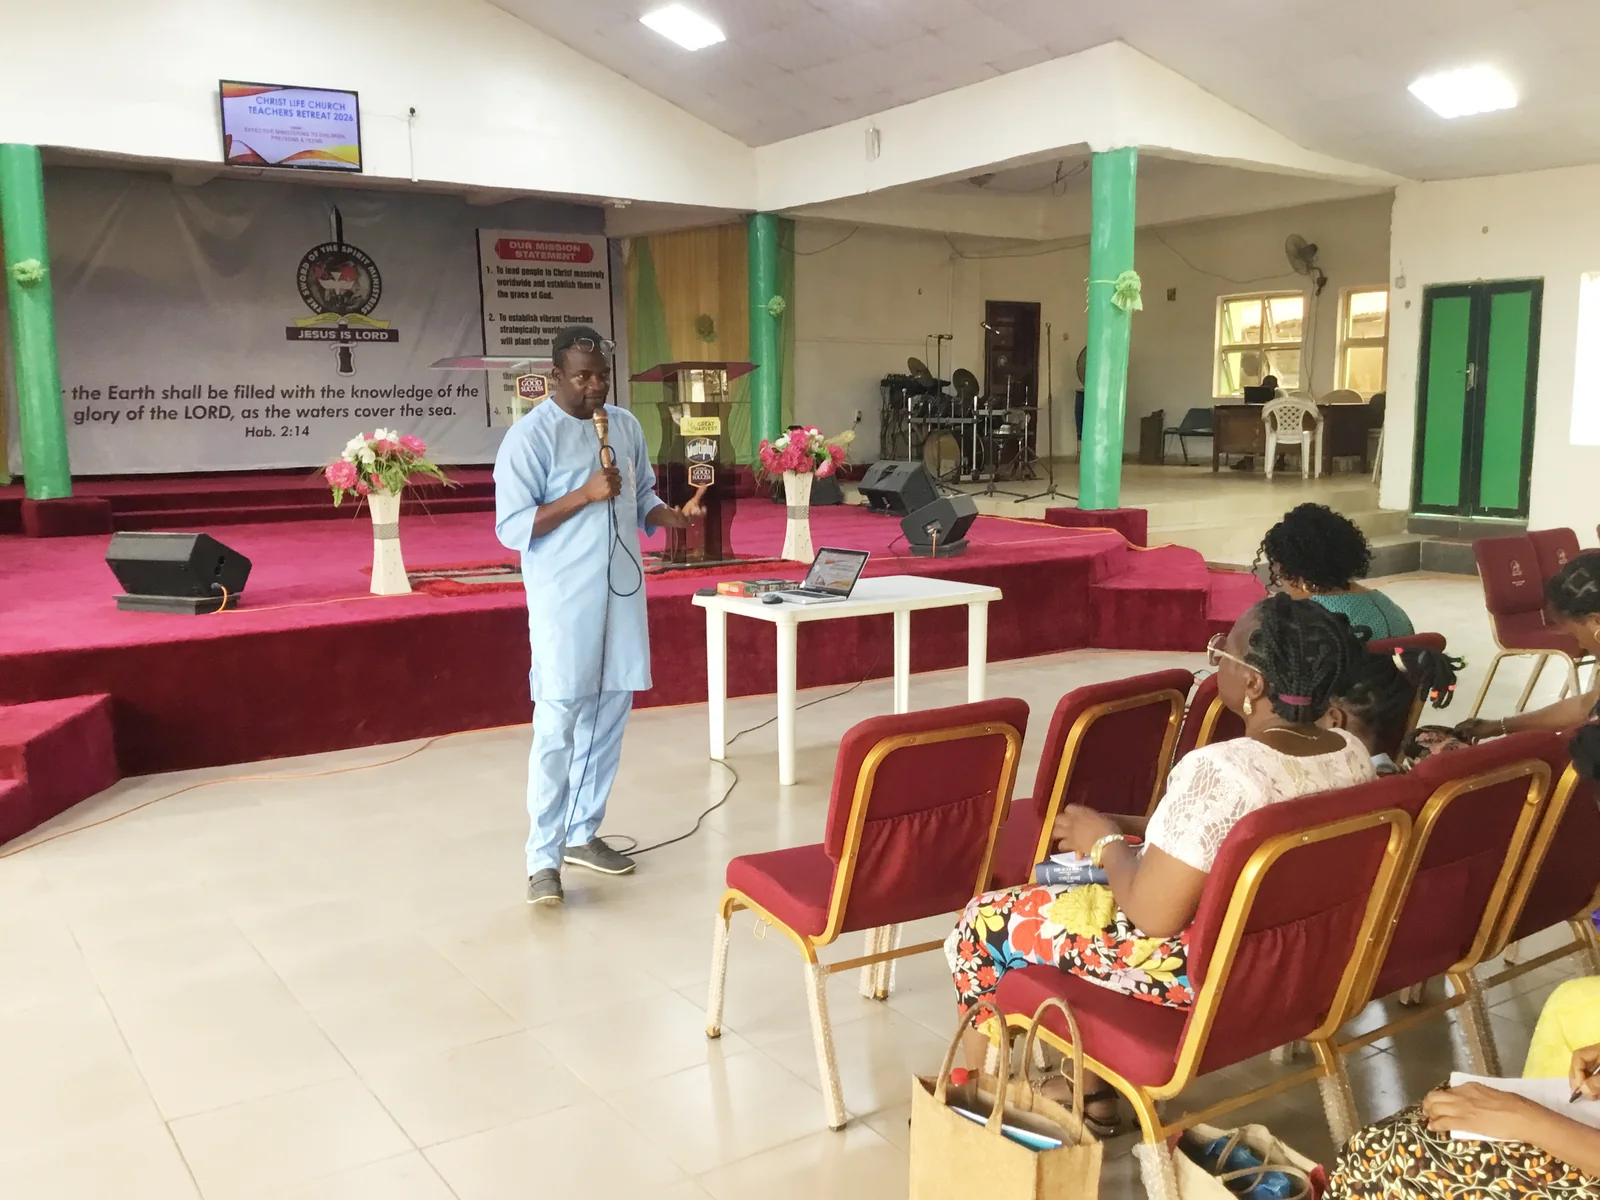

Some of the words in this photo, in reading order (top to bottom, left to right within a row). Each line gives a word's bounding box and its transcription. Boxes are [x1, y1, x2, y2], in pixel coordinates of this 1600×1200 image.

[256, 96, 286, 106] CHRIST
[289, 99, 305, 108] LIFE
[308, 101, 345, 110] CHURCH
[248, 106, 293, 117] TEACHERS
[297, 111, 331, 120] RETREAT
[334, 113, 353, 121] 2026
[320, 245, 338, 254] THE
[509, 241, 532, 249] OUR
[536, 243, 580, 252] MISSION
[308, 250, 319, 261] OF
[341, 246, 370, 265] SPIRIT
[515, 250, 576, 260] STATEMENT
[486, 266, 493, 274] 1.
[496, 266, 503, 274] To
[505, 266, 520, 274] lead
[522, 268, 543, 276] people
[545, 268, 551, 276] to
[553, 268, 572, 276] Christ
[574, 269, 604, 279] massively
[300, 262, 310, 296] SWORD
[496, 279, 531, 287] worldwide
[533, 280, 545, 288] and
[547, 280, 575, 288] establish
[361, 266, 380, 314] MINISTRIES
[497, 290, 508, 298] the
[510, 291, 529, 299] grace
[531, 291, 537, 299] of
[539, 291, 553, 299] God.
[307, 298, 322, 313] THE
[489, 314, 495, 322] 2.
[499, 314, 506, 322] To
[509, 314, 538, 322] establish
[540, 314, 562, 323] vibrant
[564, 315, 593, 323] Churches
[298, 330, 336, 339] JESUS
[340, 331, 351, 339] IS
[356, 332, 388, 340] LORD
[500, 326, 540, 335] strategically
[501, 337, 513, 345] will
[515, 338, 531, 346] plant
[533, 338, 549, 346] other
[72, 385, 100, 400] the
[108, 385, 154, 400] Earth
[162, 385, 201, 400] shall
[208, 385, 228, 399] be
[234, 384, 275, 399] filled
[281, 385, 315, 399] with
[320, 385, 345, 399] the
[351, 385, 433, 401] knowledge
[438, 384, 452, 398] of
[456, 384, 479, 397] the
[74, 406, 120, 425] glory
[126, 405, 144, 420] of
[150, 405, 178, 420] the
[185, 405, 235, 421] LORD,
[241, 407, 259, 419] as
[265, 405, 290, 419] the
[297, 405, 349, 418] waters
[354, 407, 395, 417] cover
[400, 404, 425, 416] the
[428, 405, 456, 416] sea.
[245, 427, 275, 438] Hab.
[280, 426, 309, 437] 2:14
